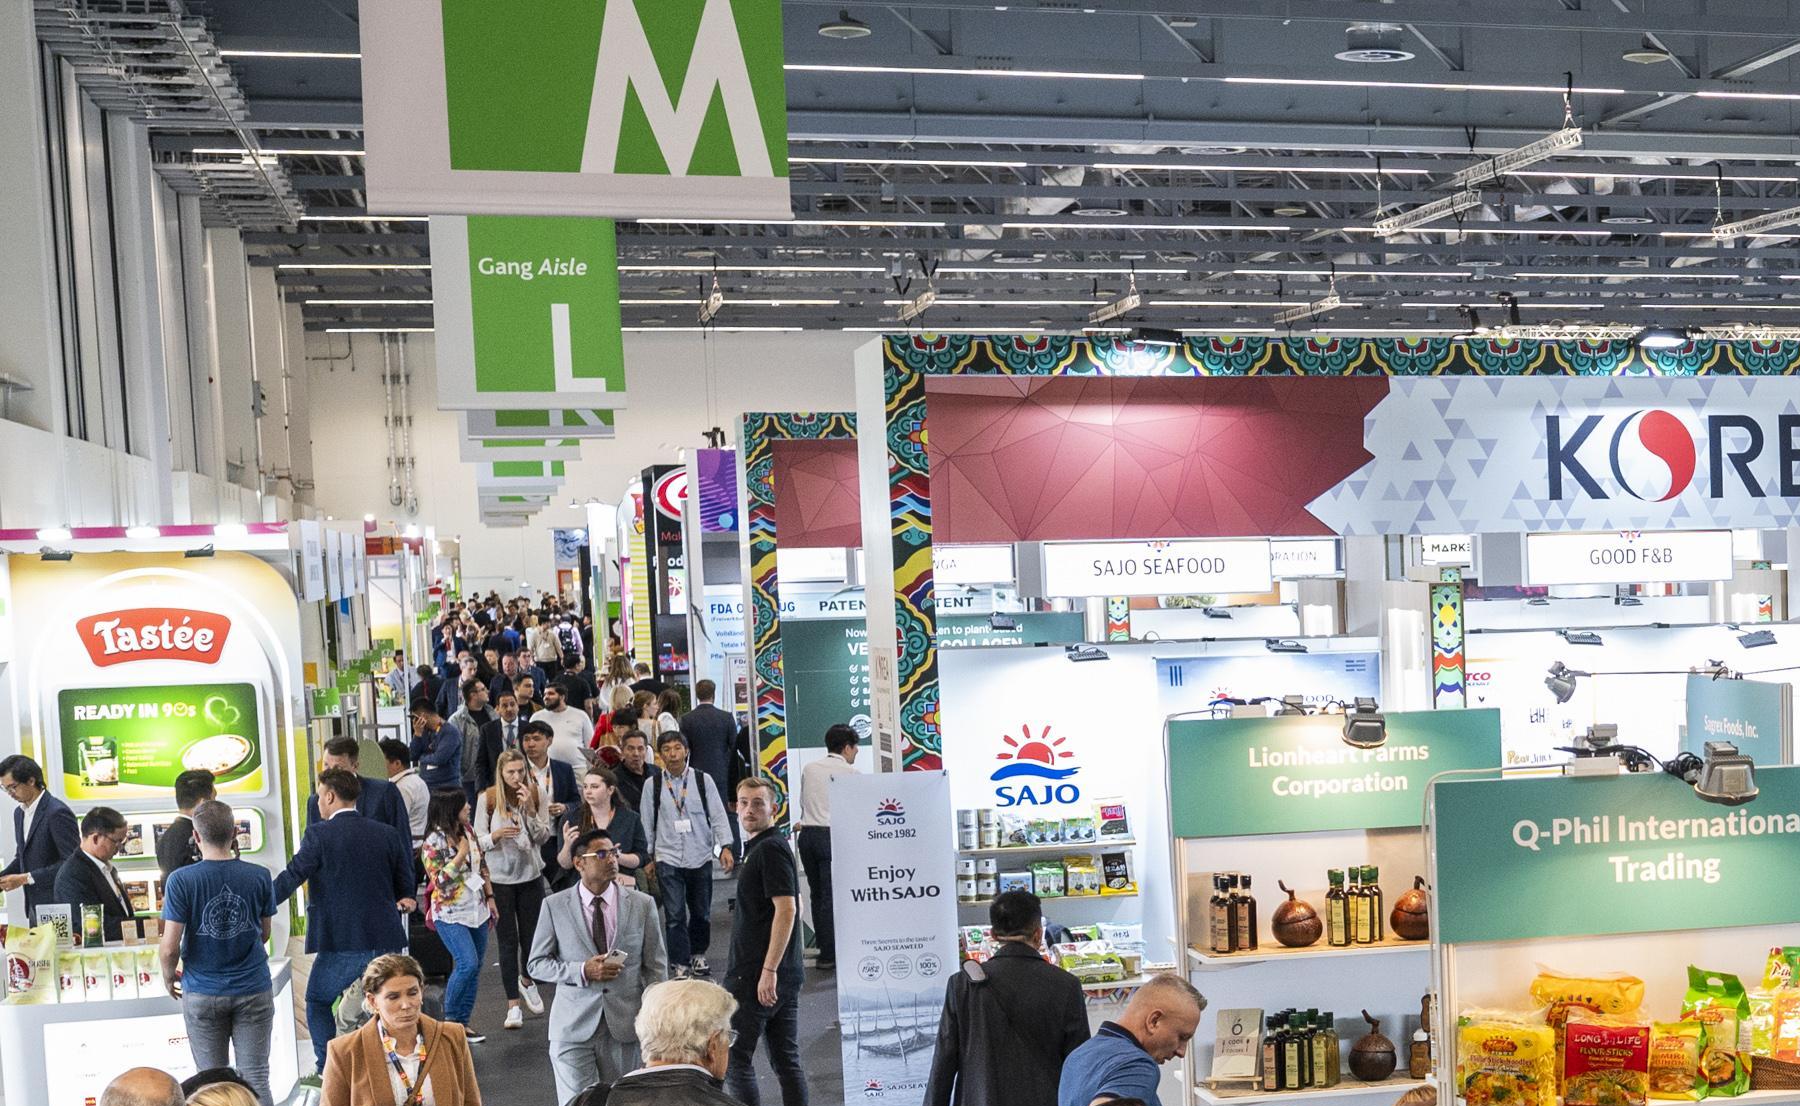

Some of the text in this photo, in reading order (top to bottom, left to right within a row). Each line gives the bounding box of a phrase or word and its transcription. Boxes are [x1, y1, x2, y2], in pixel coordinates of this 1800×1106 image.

[580, 0, 774, 177] M
[477, 257, 588, 281] Gang Aisle
[550, 303, 607, 392] L
[1590, 548, 1673, 566] GOOD F&B
[1093, 556, 1226, 577] SAJO SEAFOOD
[711, 603, 732, 614] FDA
[93, 615, 216, 656] Tastée
[314, 689, 327, 698] 1.2
[74, 703, 136, 721] READY
[138, 703, 159, 719] IN
[1271, 773, 1409, 798] Corporation
[995, 783, 1081, 808] SAJO
[877, 817, 906, 826] SAJO
[867, 829, 917, 840] Since 1982
[1512, 815, 1610, 852] Q-Phil
[867, 865, 916, 883] Enjoy
[1608, 853, 1721, 884] Trading
[850, 885, 941, 902] With SAJO
[1574, 1033, 1642, 1046] LONG LIFE
[1606, 1047, 1634, 1057] STICKS
